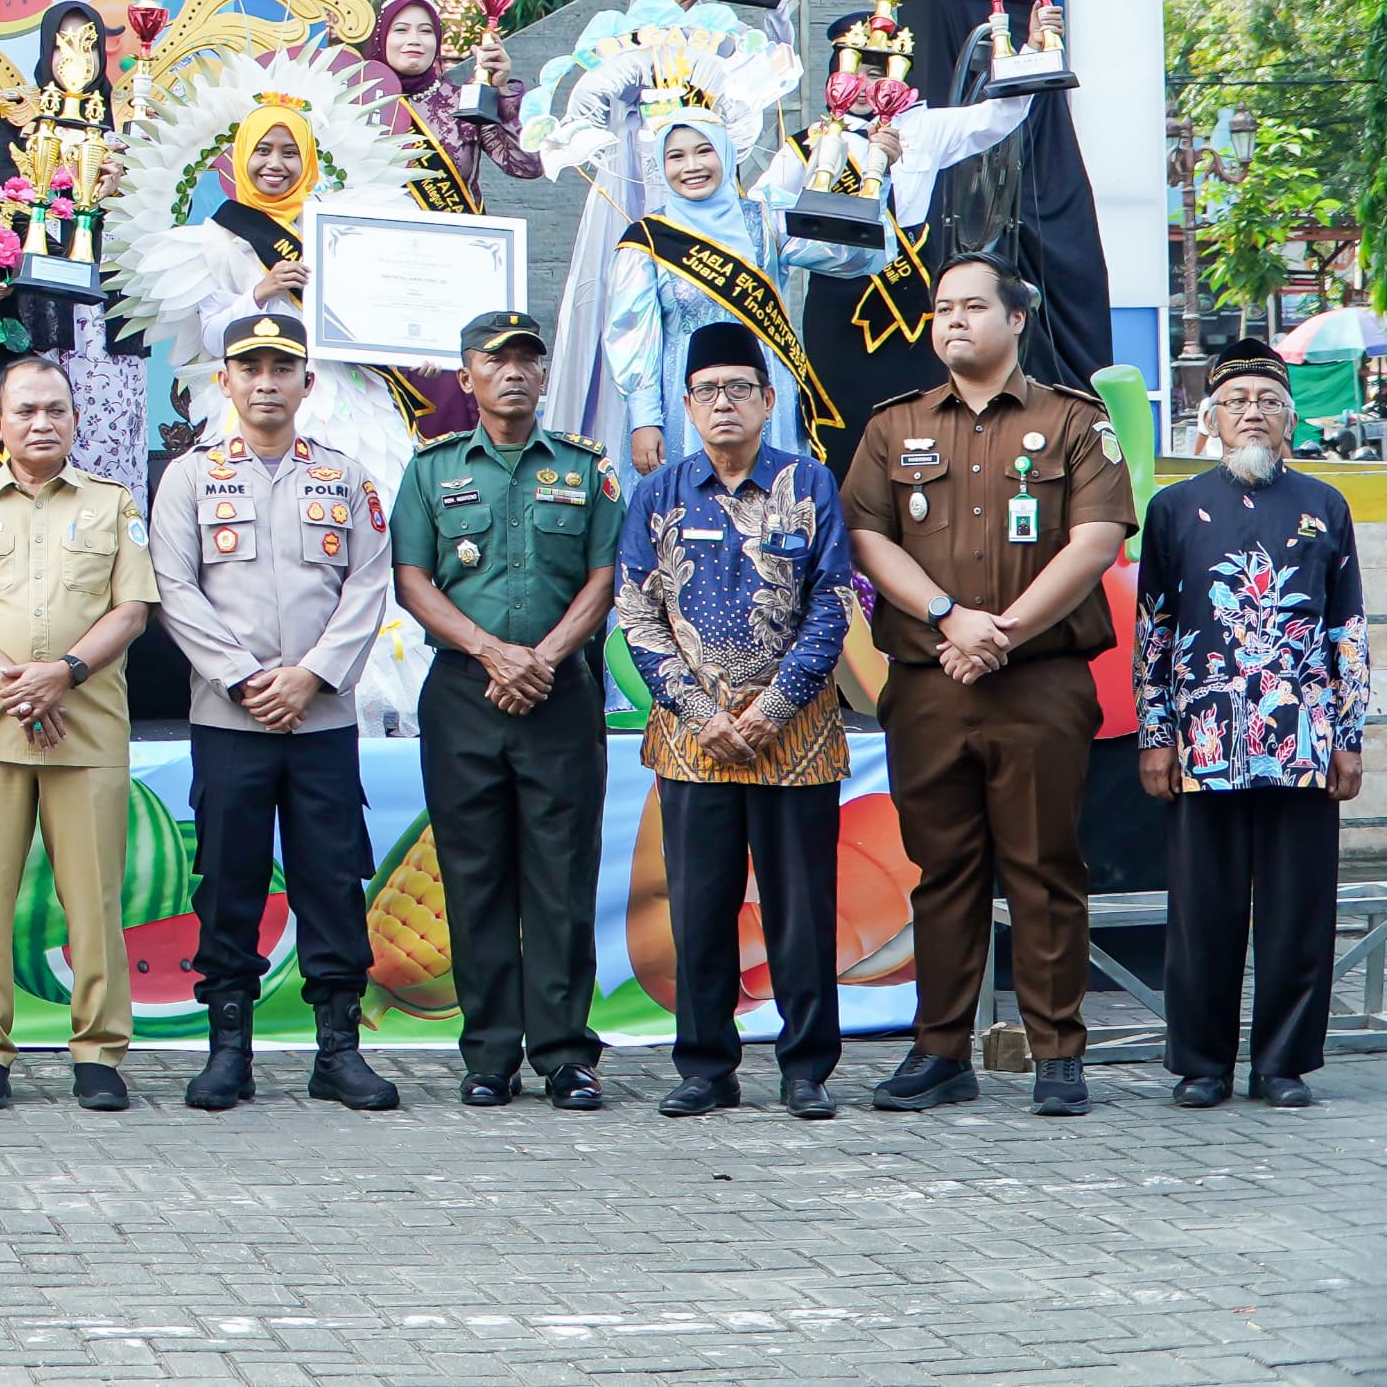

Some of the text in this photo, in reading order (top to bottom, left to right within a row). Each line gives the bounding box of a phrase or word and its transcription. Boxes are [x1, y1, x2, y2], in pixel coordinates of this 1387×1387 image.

[682, 256, 726, 287] Juara
[731, 286, 743, 298] 1
[689, 245, 734, 277] LAELA
[735, 272, 765, 302] EKA
[205, 483, 246, 496] MADE
[304, 485, 348, 498] POLRI
